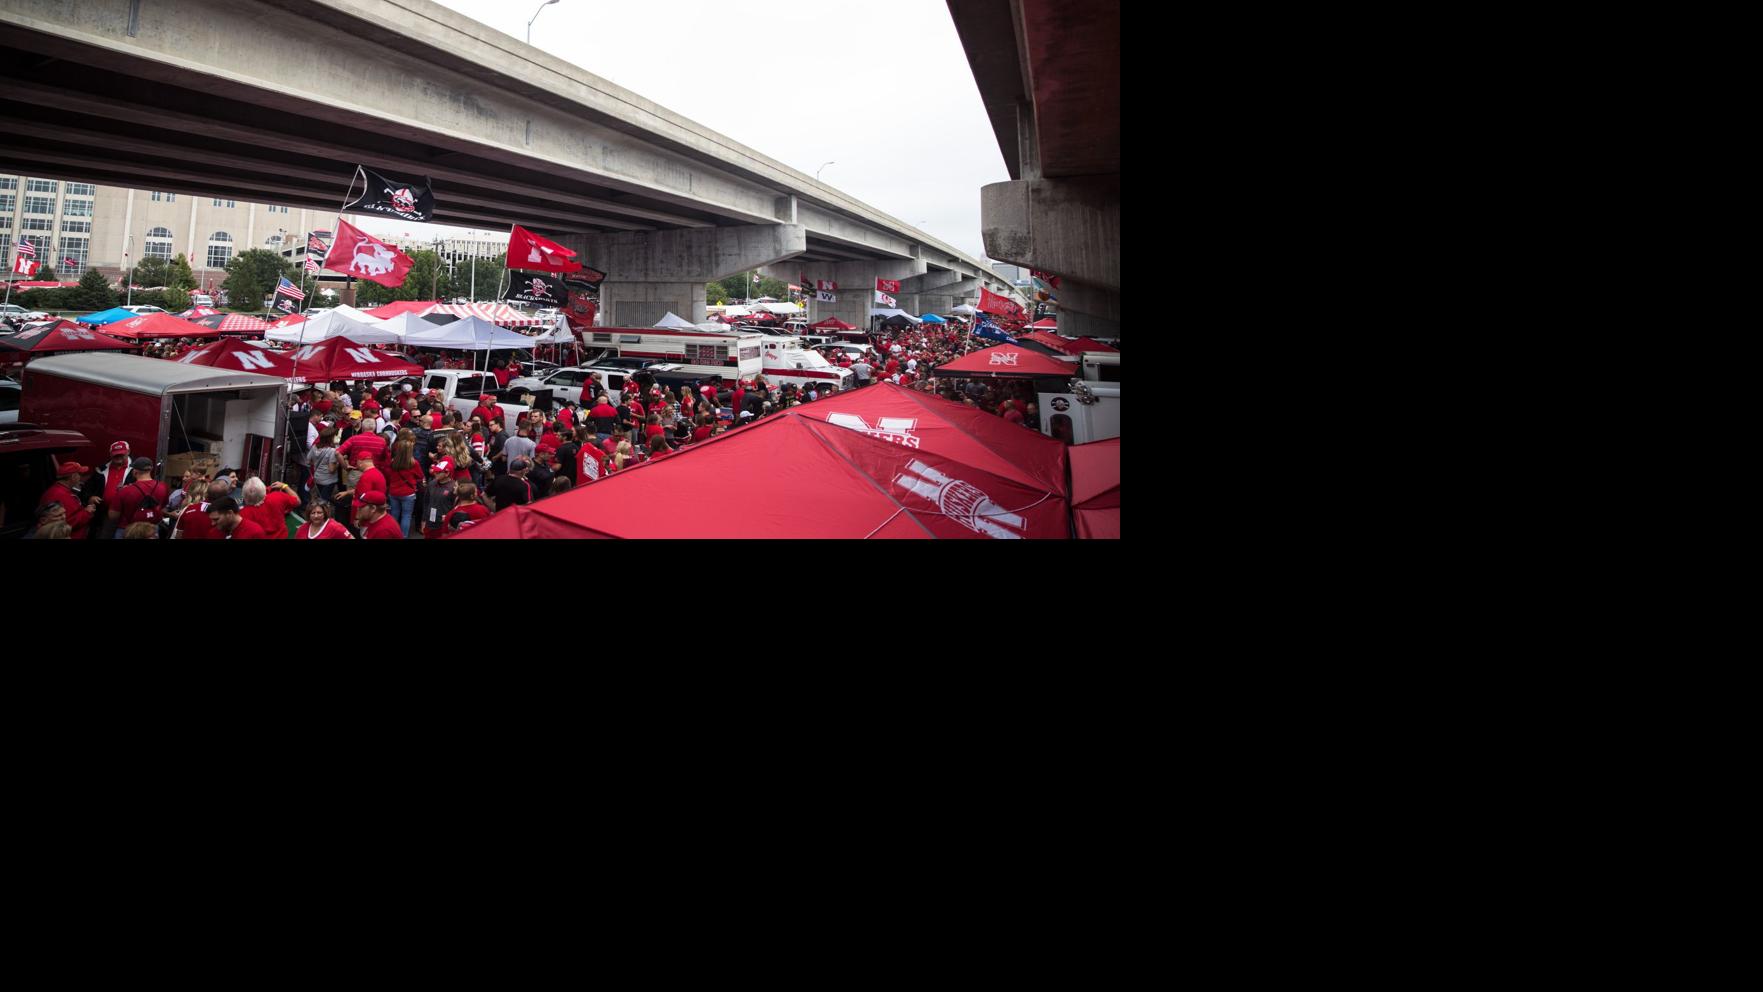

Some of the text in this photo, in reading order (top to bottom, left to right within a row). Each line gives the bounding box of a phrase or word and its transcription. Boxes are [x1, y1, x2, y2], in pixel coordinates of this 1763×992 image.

[19, 257, 33, 275] N
[821, 292, 833, 301] W
[231, 350, 277, 370] N
[290, 345, 327, 361] N
[344, 346, 382, 364] N
[988, 351, 1019, 366] N
